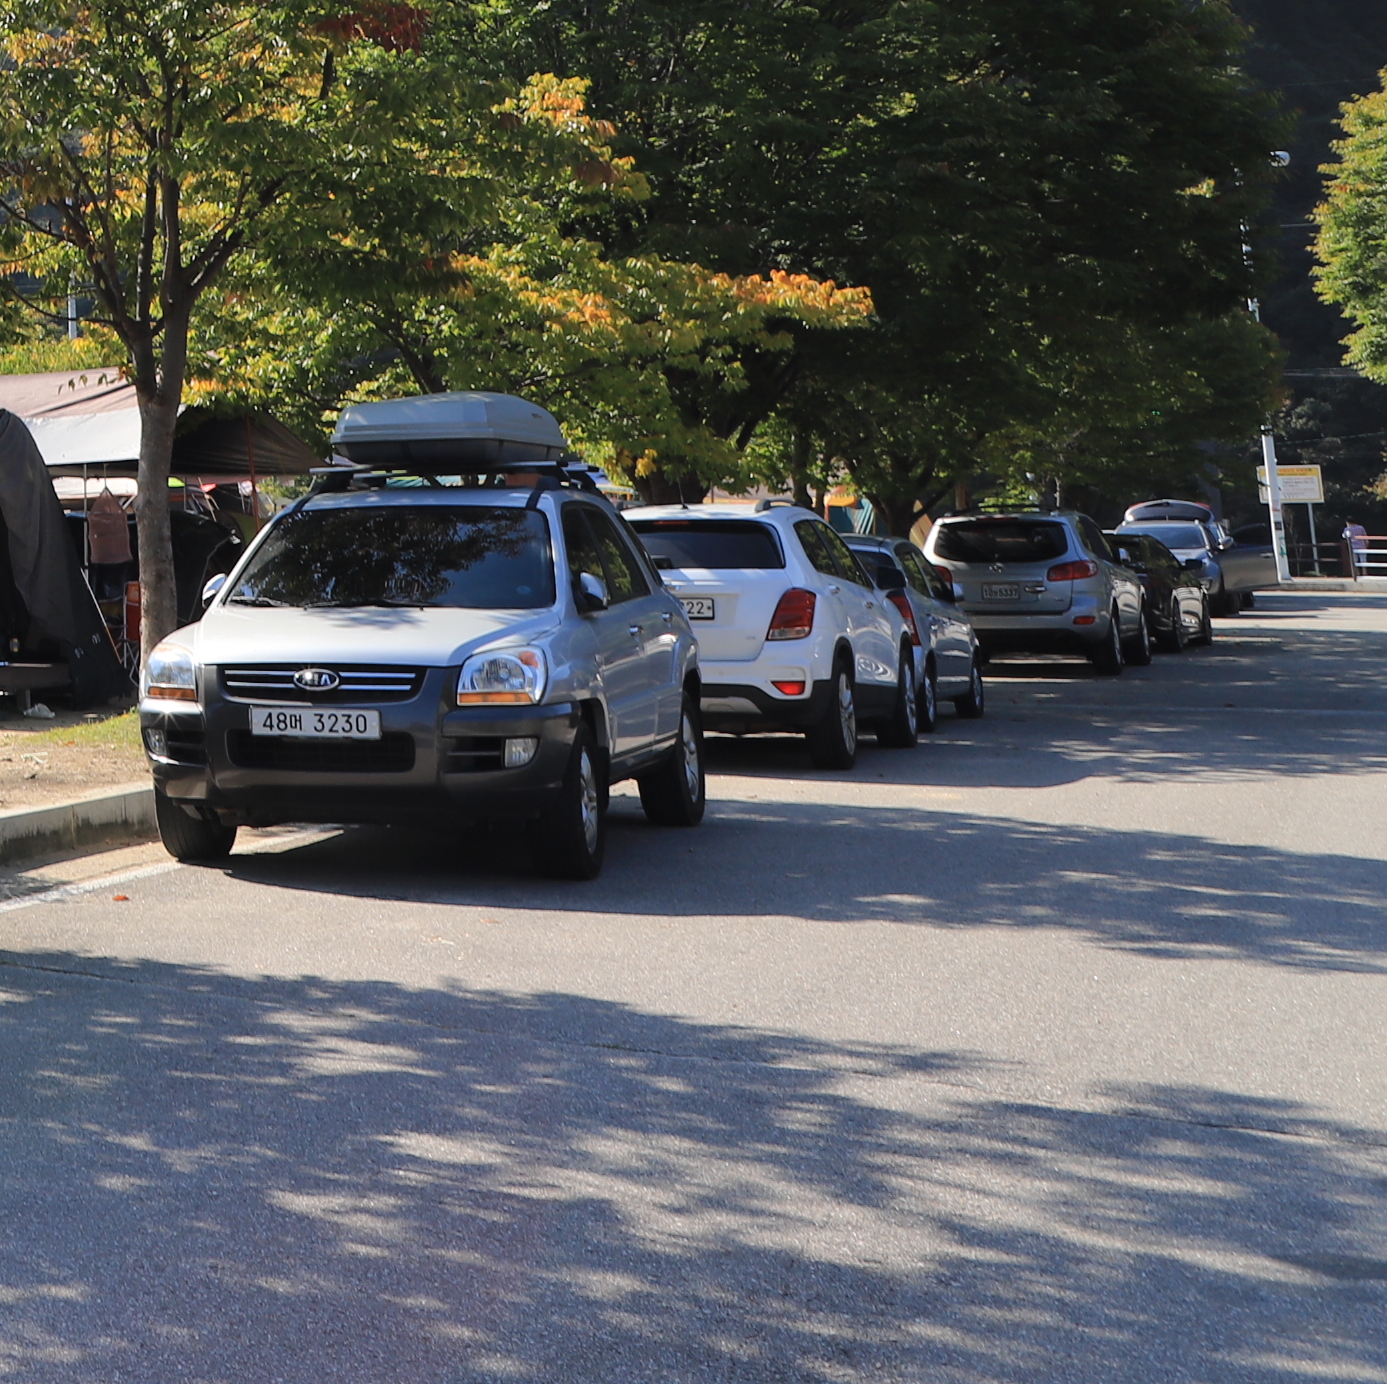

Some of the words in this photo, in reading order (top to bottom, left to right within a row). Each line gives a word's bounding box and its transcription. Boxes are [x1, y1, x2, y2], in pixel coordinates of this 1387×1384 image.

[681, 600, 705, 615] 22
[262, 712, 303, 732] 48머
[313, 713, 368, 734] 3230
